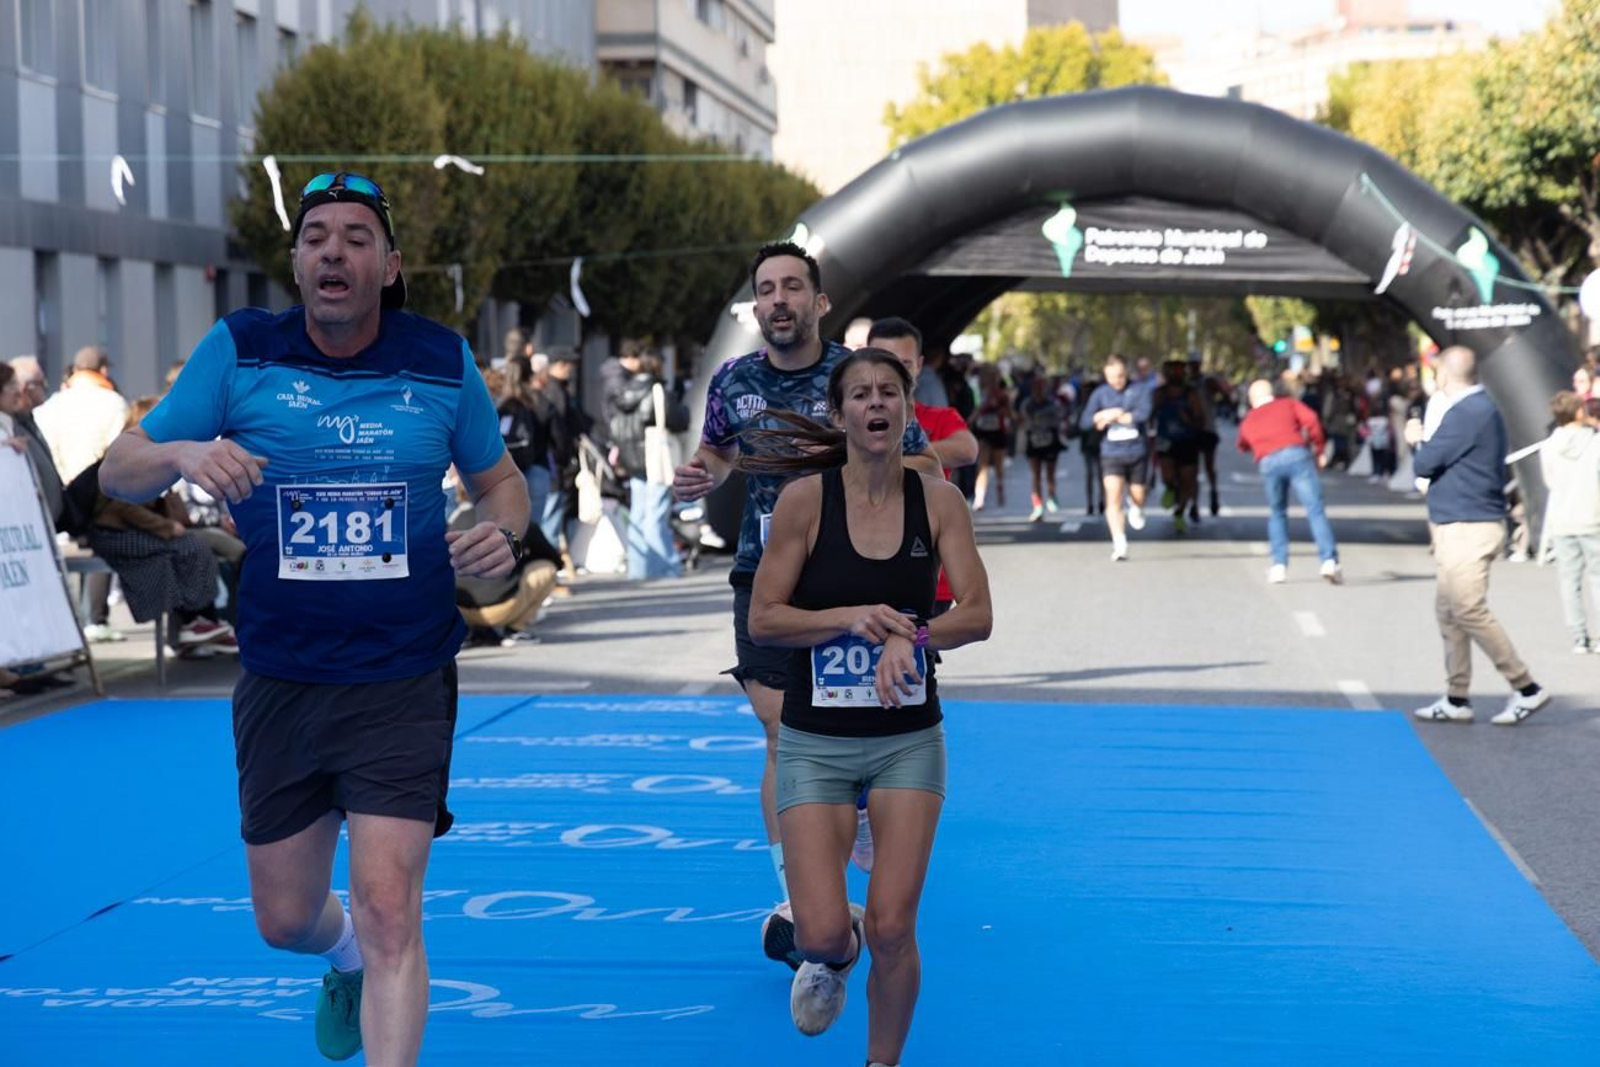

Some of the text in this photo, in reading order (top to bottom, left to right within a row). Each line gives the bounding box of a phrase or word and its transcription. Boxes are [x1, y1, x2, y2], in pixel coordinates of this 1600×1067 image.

[1085, 227, 1268, 248] Patronato Municipal de
[1085, 245, 1226, 265] Deportes de Jaén
[290, 511, 392, 544] 2181
[338, 544, 373, 553] ANTONIO
